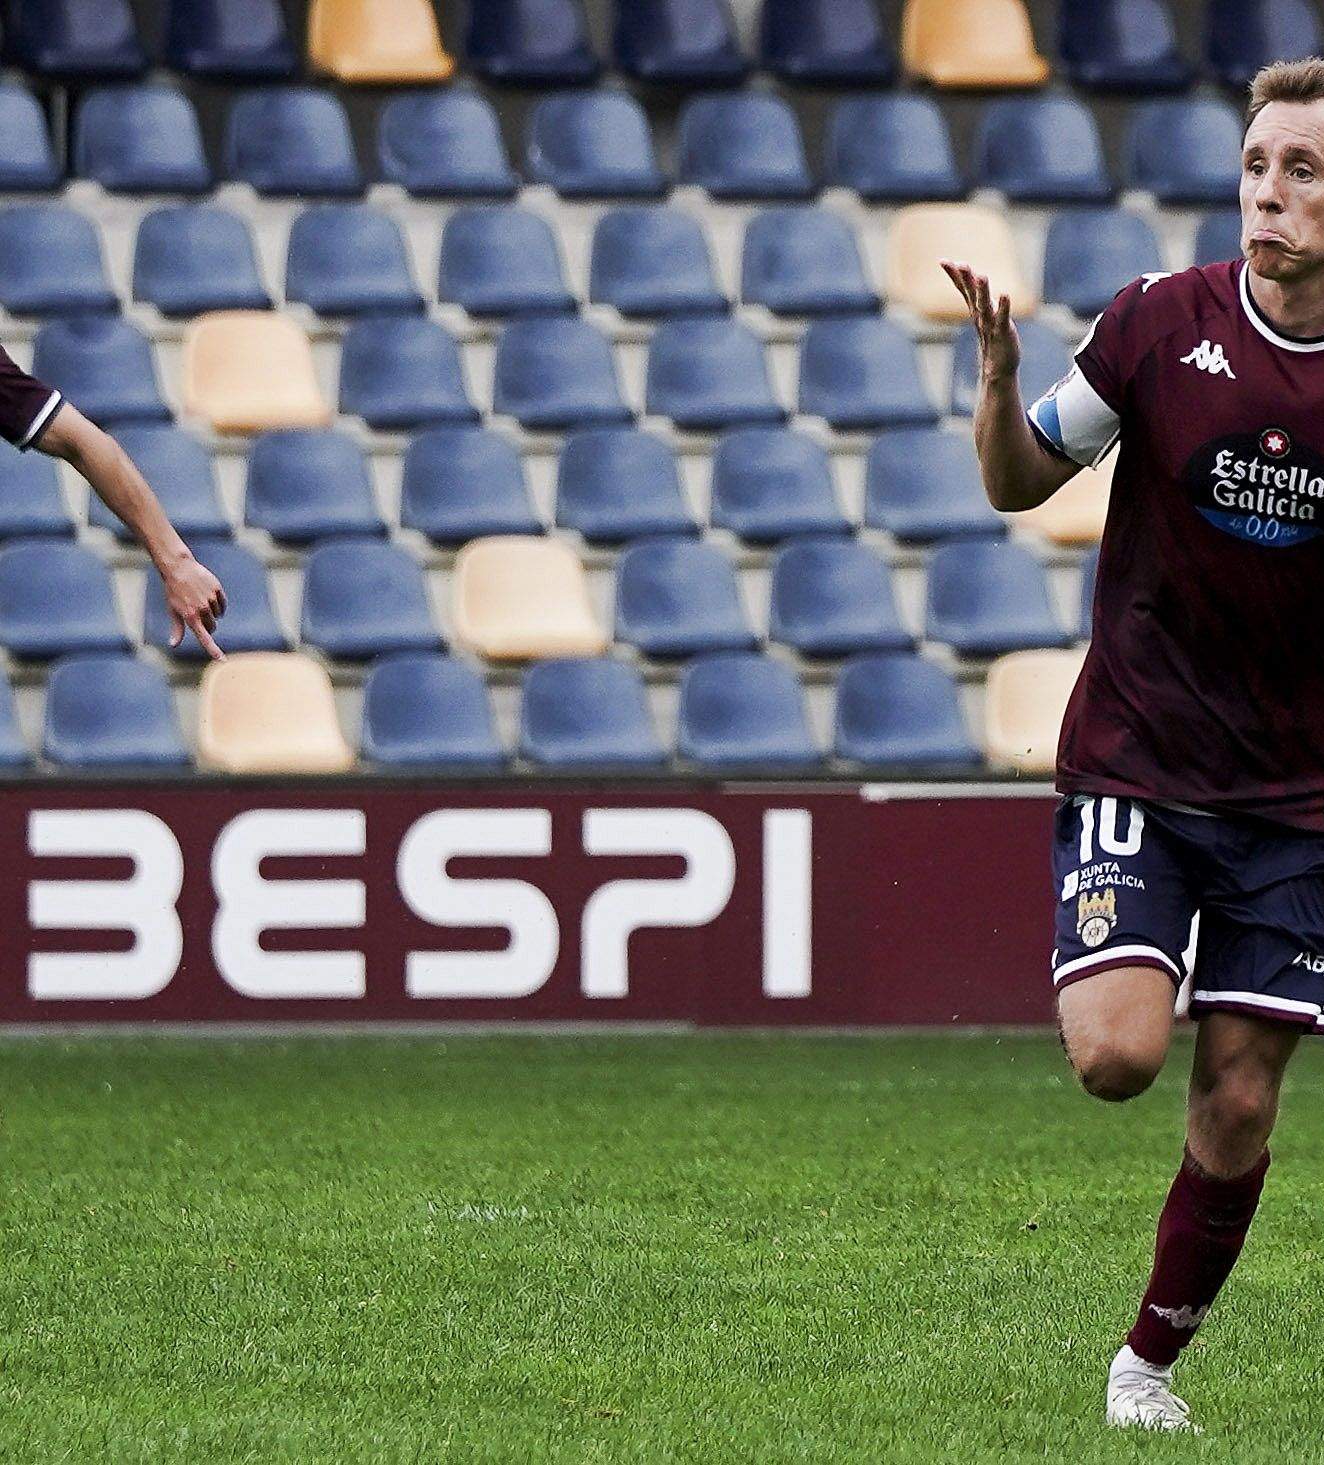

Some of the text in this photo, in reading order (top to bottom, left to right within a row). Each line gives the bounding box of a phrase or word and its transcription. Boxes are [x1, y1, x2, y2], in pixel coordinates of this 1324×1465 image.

[1213, 479, 1315, 520] Galicia
[1245, 515, 1280, 540] 0,0
[1073, 797, 1145, 864] 10
[1079, 874, 1145, 892] DE GALICIA
[1080, 861, 1120, 881] XUNTA
[27, 807, 813, 1000] BESPI
